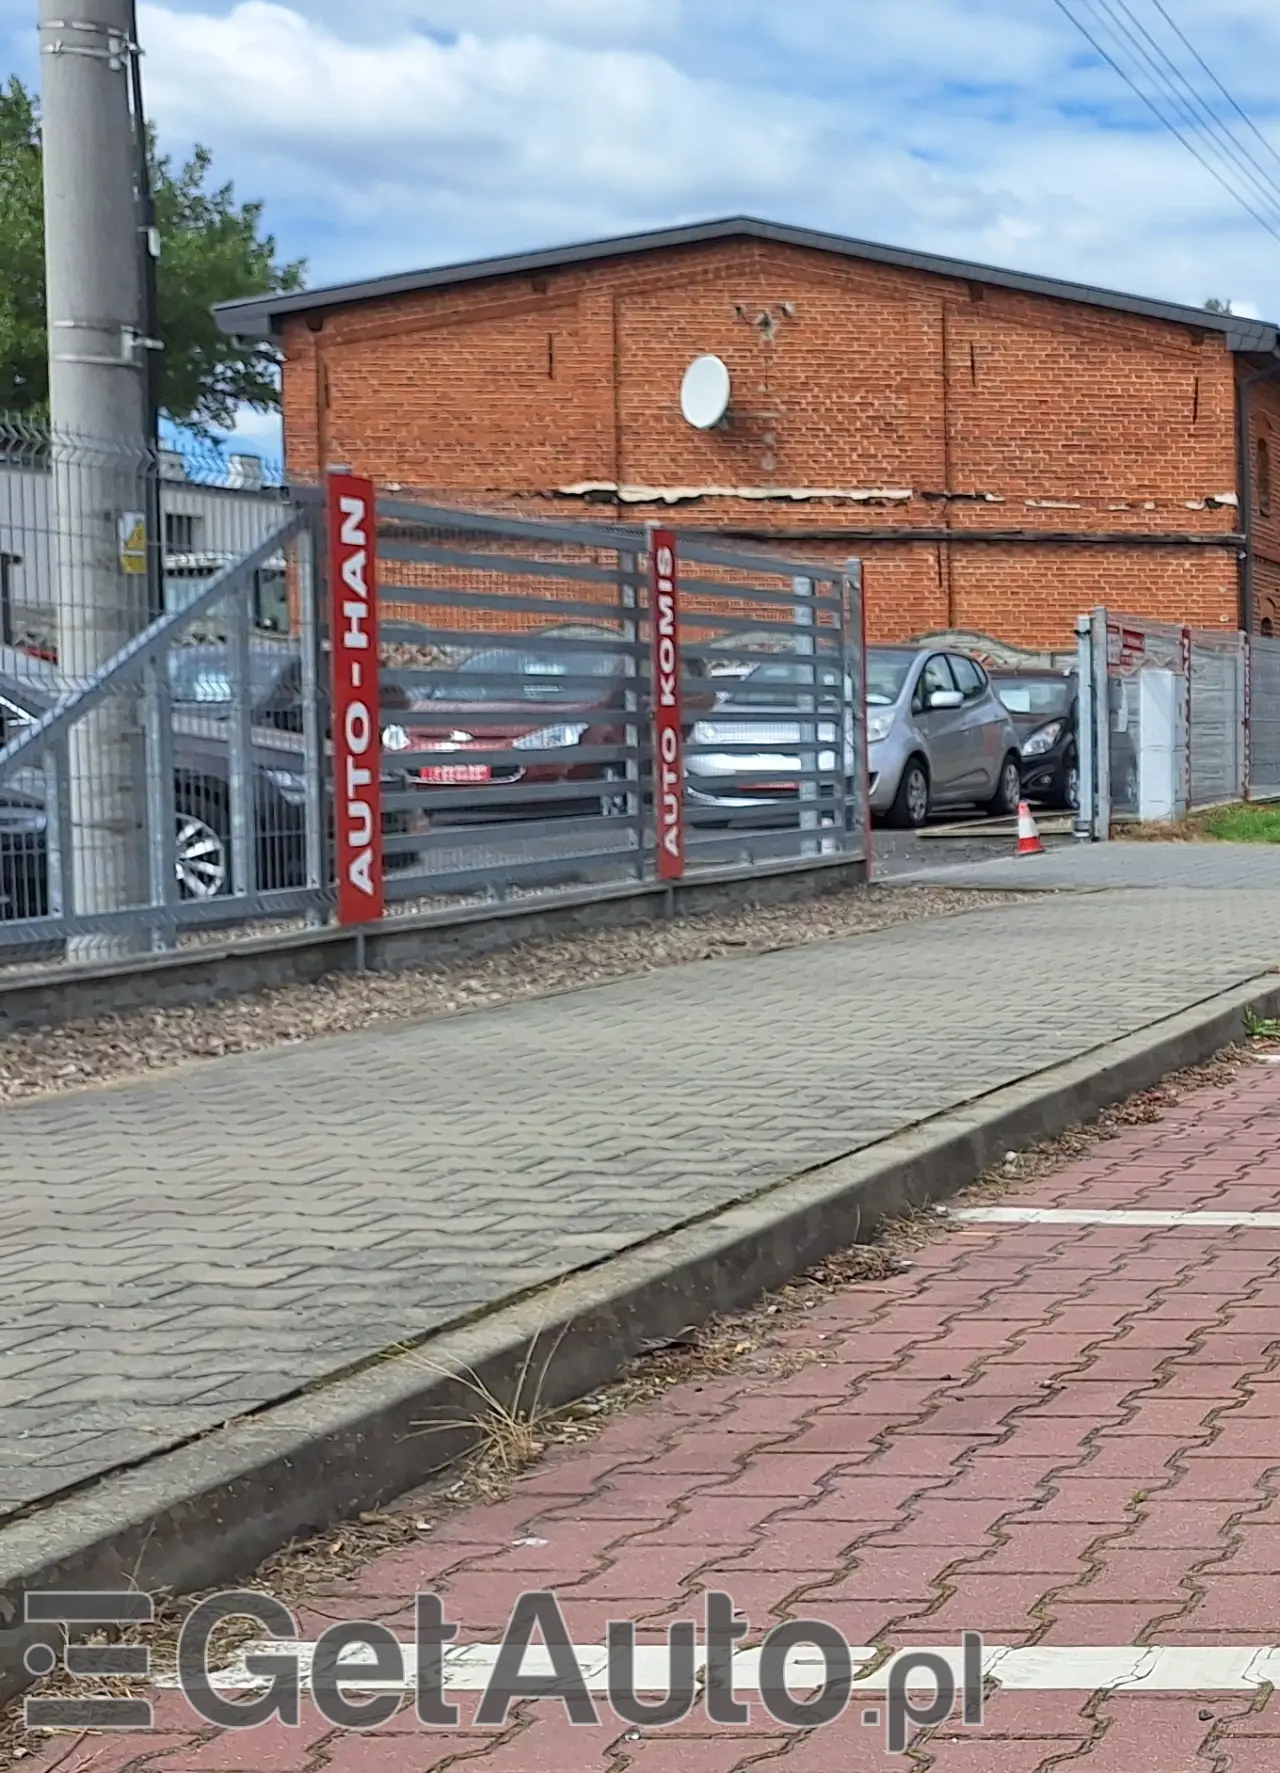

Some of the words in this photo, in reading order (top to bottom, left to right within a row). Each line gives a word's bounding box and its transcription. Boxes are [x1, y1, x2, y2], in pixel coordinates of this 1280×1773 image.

[339, 495, 369, 648] HAN
[656, 546, 676, 706] KOMIS
[344, 701, 373, 895] AUTO
[661, 727, 680, 857] AUTO
